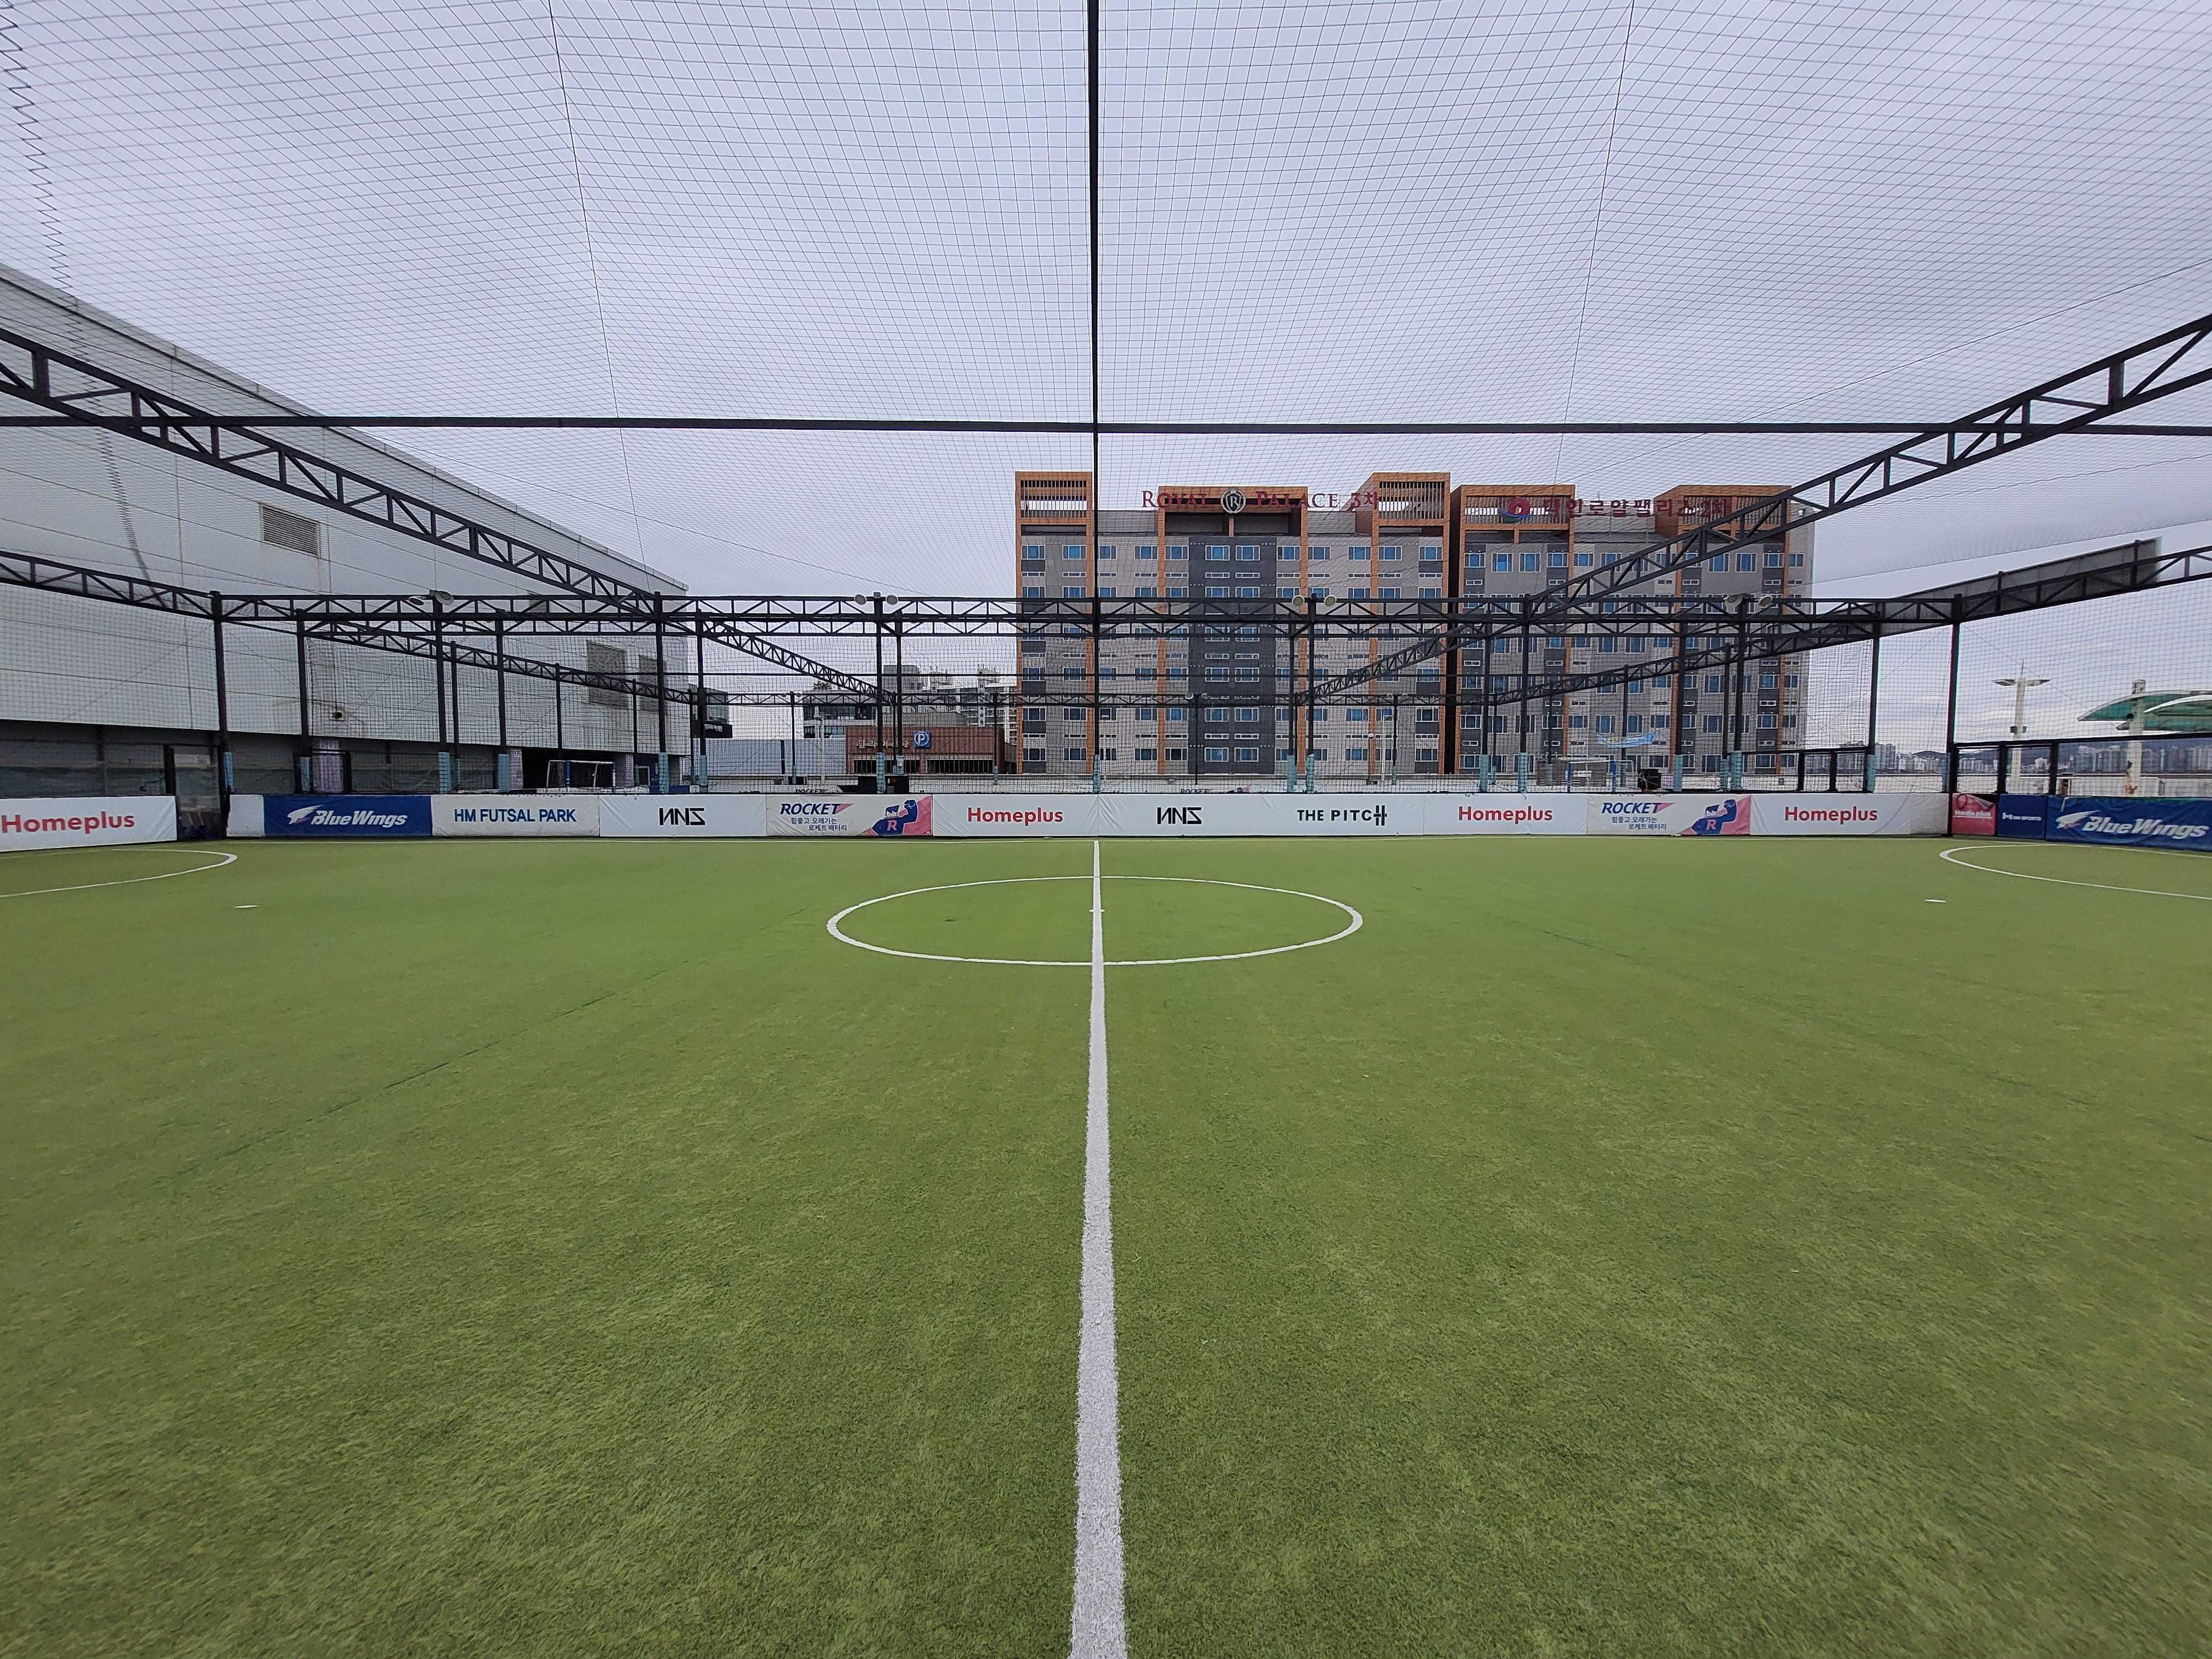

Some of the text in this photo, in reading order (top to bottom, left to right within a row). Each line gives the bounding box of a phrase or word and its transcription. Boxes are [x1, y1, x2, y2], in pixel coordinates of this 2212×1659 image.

[1141, 491, 1207, 508] ROYAL
[1256, 491, 1339, 508] PALACE
[454, 808, 577, 822] HM FUTSAL PARK
[780, 803, 841, 815] ROCKET
[1297, 805, 1387, 826] THE PITCH
[1458, 805, 1553, 825] Homeplus
[1601, 802, 1662, 814] ROCKET
[1785, 806, 1878, 825] Homeplus
[1, 811, 135, 834] Homeplus
[886, 820, 898, 831] R
[968, 807, 1063, 827] Homeplus
[1706, 819, 1717, 831] R
